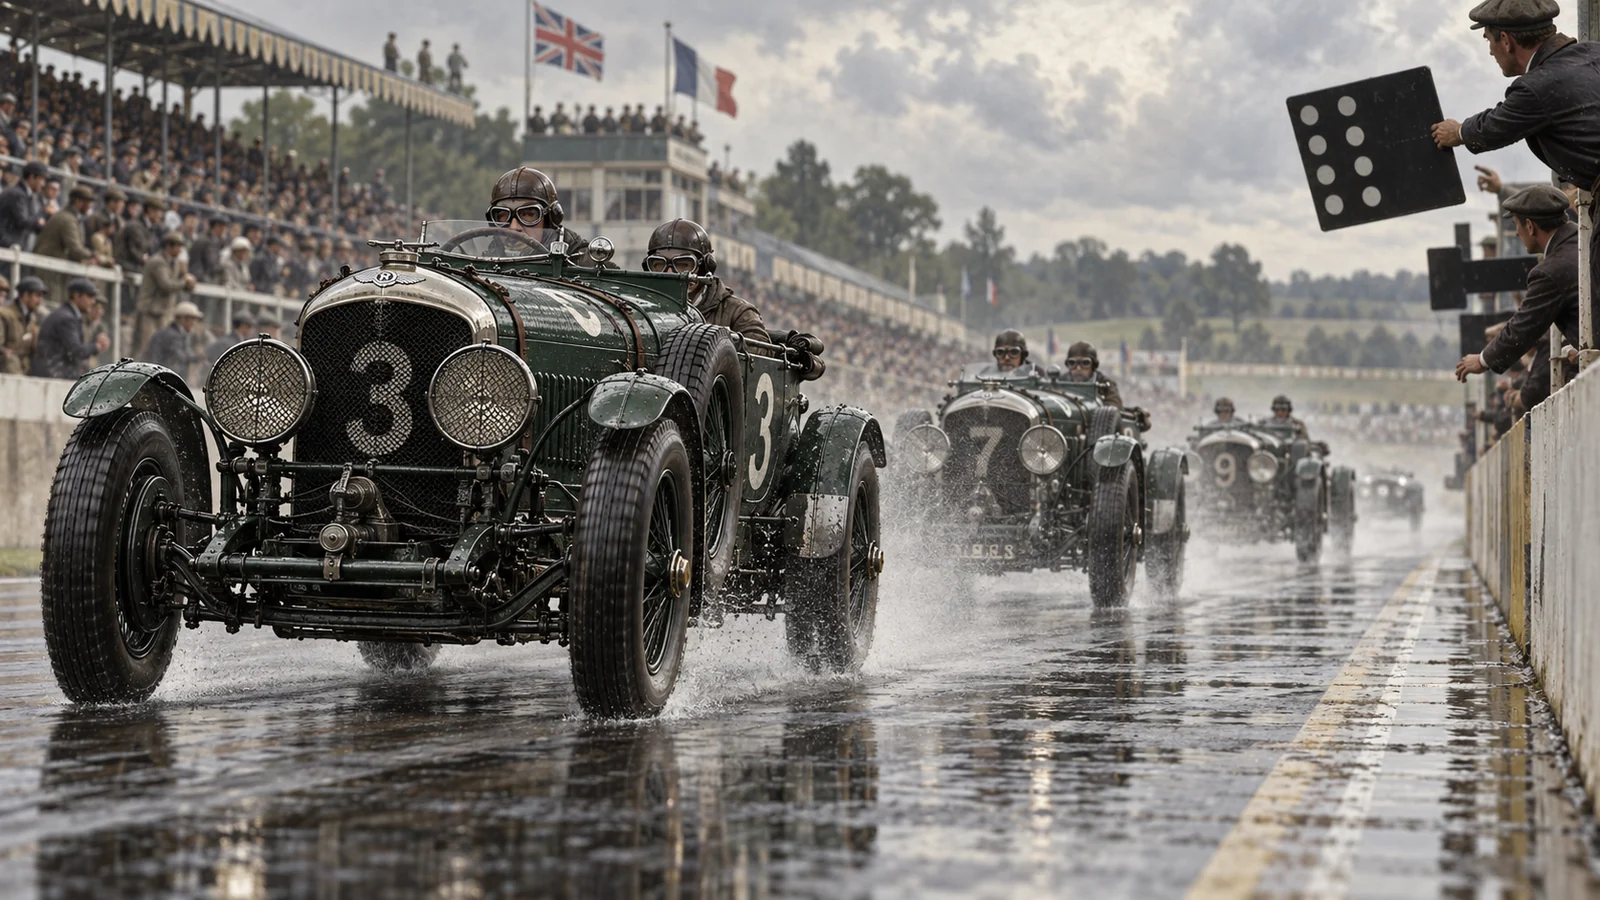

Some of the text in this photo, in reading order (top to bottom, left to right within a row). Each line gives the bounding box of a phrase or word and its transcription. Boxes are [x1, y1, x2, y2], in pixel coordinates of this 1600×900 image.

[346, 341, 413, 455] 3
[748, 372, 774, 490] 3
[969, 426, 1003, 479] 7
[1214, 451, 1236, 488] 9
